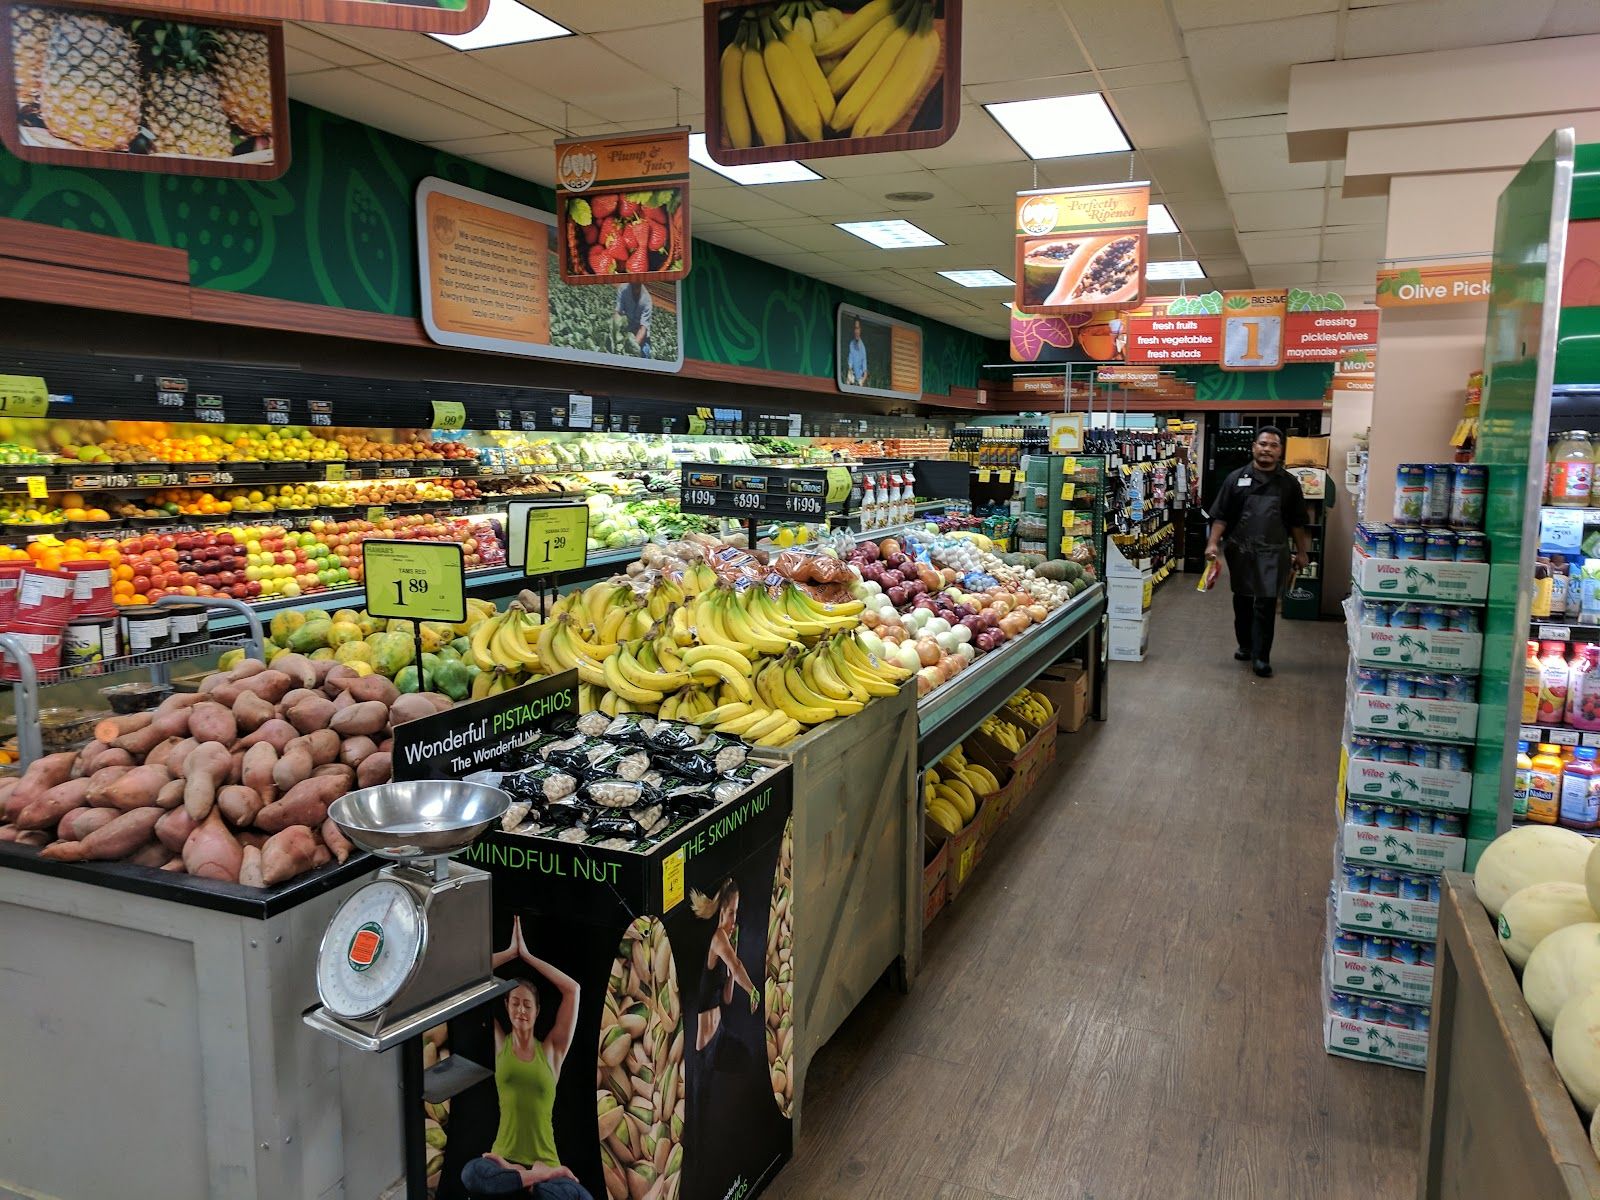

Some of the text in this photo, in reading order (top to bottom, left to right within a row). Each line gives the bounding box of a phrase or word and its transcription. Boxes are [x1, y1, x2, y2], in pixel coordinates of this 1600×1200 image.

[608, 146, 661, 163] Plump &
[642, 159, 675, 175] Juicy
[1068, 198, 1119, 213] Perfectly
[1088, 207, 1136, 222] Ripened
[1399, 280, 1492, 300] Olive Pick
[1266, 295, 1288, 304] SAVE
[1152, 319, 1198, 330] fresh fruits
[1314, 317, 1356, 328] dressing
[1137, 334, 1212, 346] fresh vegetables
[1242, 322, 1263, 360] 1
[1301, 331, 1368, 344] pickles/olives
[1147, 348, 1201, 360] fresh salads
[1286, 348, 1338, 358] mayonnaise
[1344, 360, 1374, 372] Mayo
[451, 757, 472, 773] The
[473, 736, 523, 765] Wonderful
[682, 830, 706, 860] THE
[708, 804, 750, 846] SKINNY
[752, 788, 772, 818] NUT
[466, 842, 566, 876] MINDFUL
[574, 857, 622, 884] NUT
